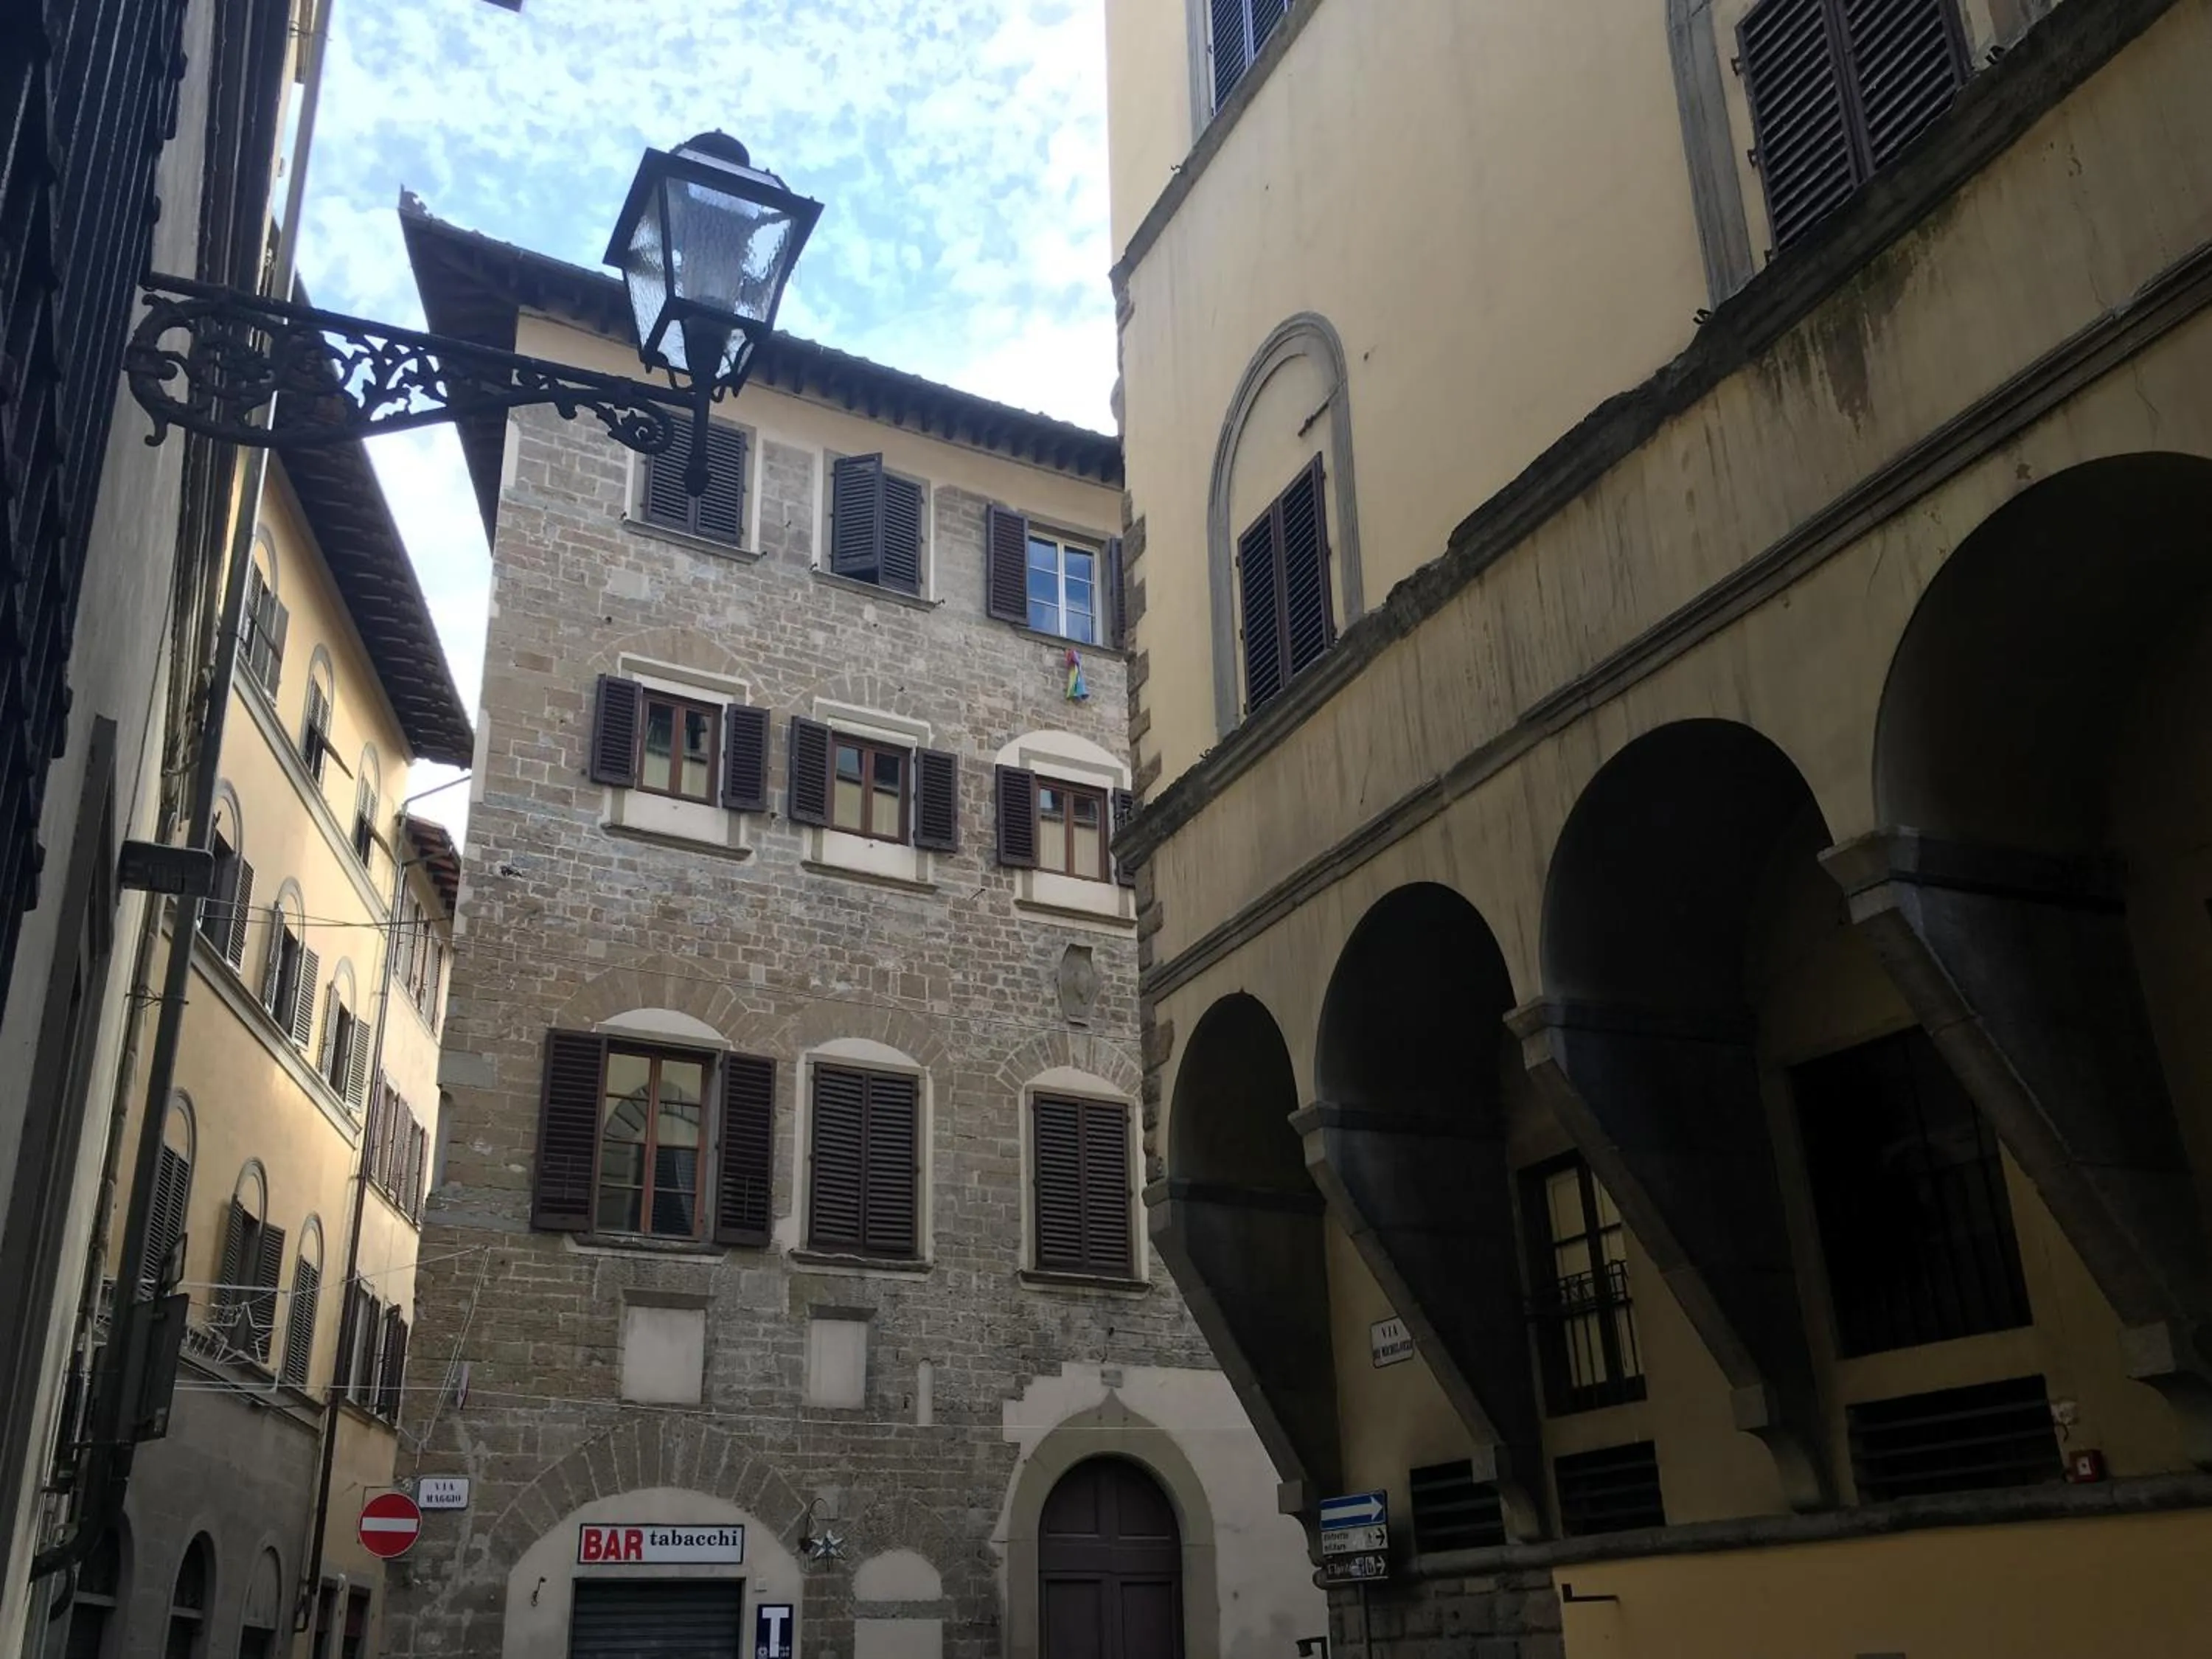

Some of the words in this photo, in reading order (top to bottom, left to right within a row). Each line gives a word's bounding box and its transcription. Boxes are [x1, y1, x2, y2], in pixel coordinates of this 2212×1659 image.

[1381, 1324, 1399, 1338] VIA
[434, 1481, 456, 1491] VIA
[426, 1493, 461, 1503] MAGGIO
[582, 1528, 644, 1561] BAR
[649, 1529, 738, 1547] tabacchi
[762, 1607, 790, 1658] T
